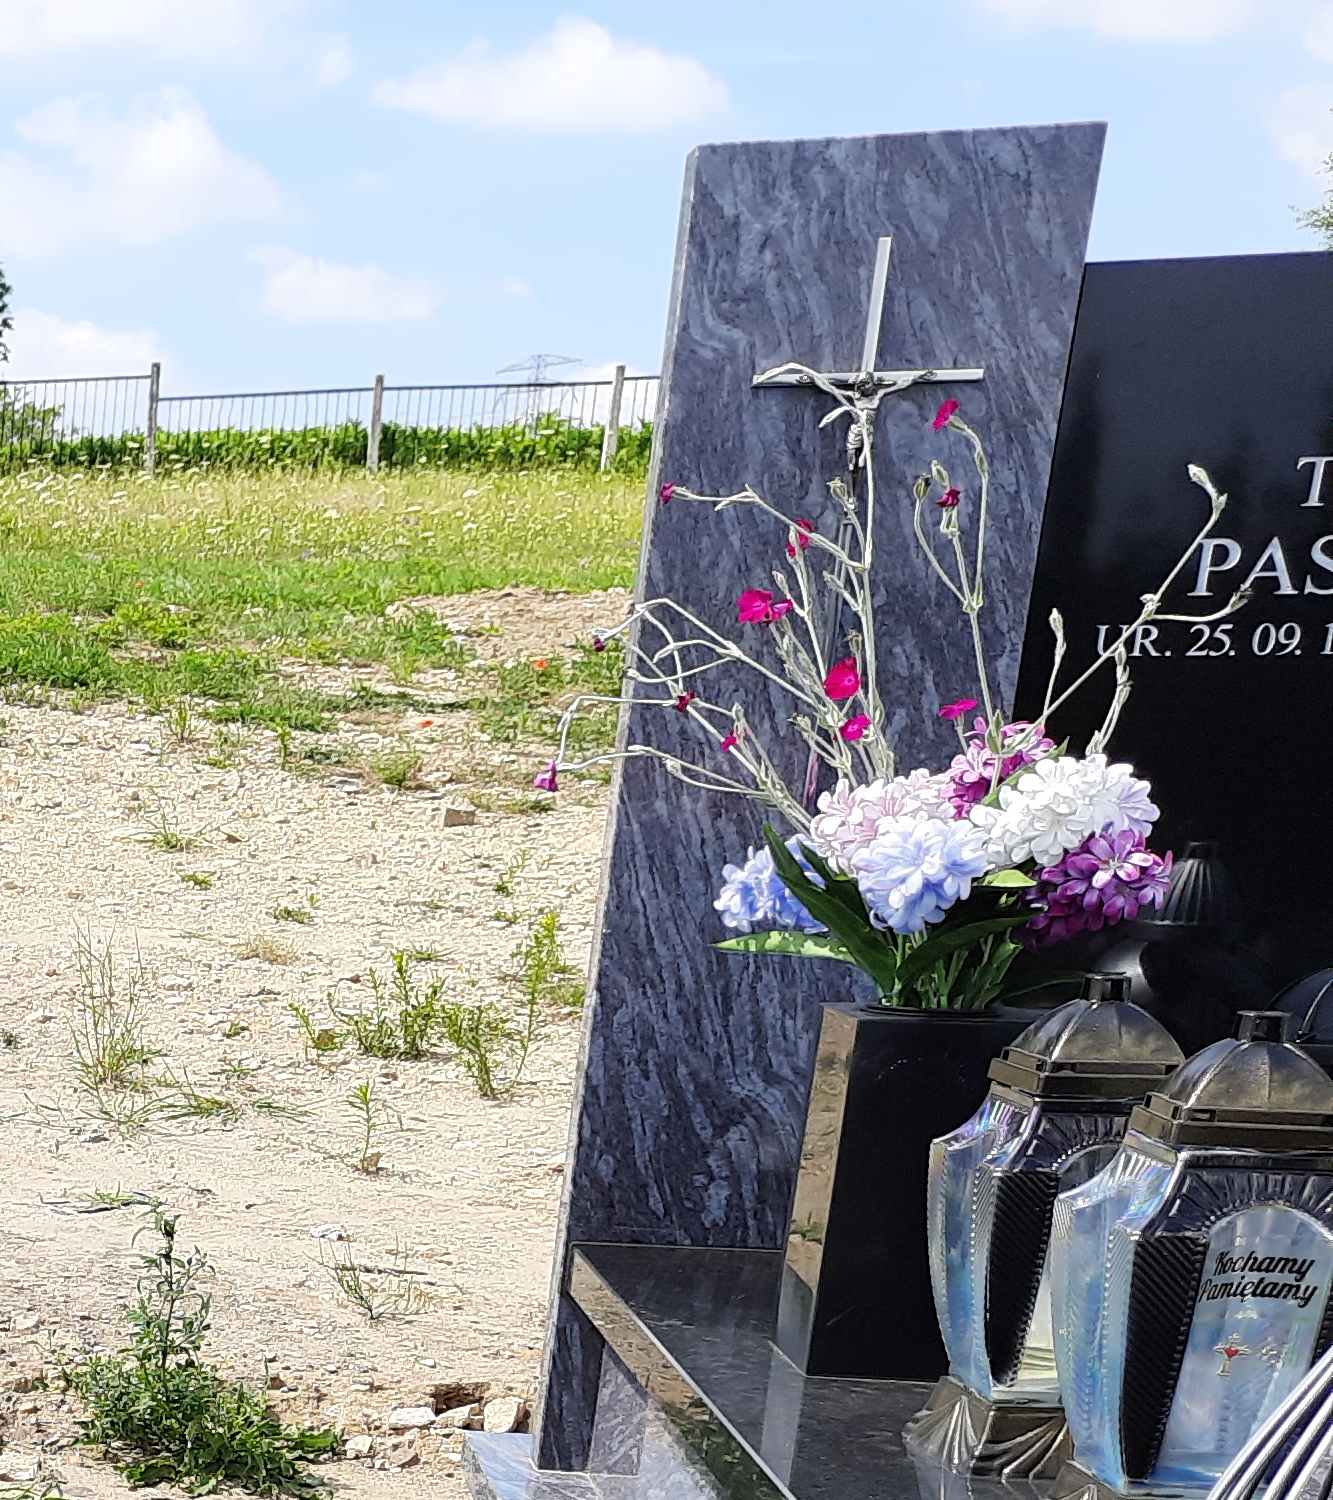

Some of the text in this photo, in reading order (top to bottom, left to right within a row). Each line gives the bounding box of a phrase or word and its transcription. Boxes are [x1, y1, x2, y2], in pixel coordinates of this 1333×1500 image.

[1185, 623, 1236, 656] 25.
[1251, 622, 1301, 656] 09.
[1213, 1251, 1316, 1282] Kochamy
[1198, 1275, 1319, 1308] Pamiętamy
